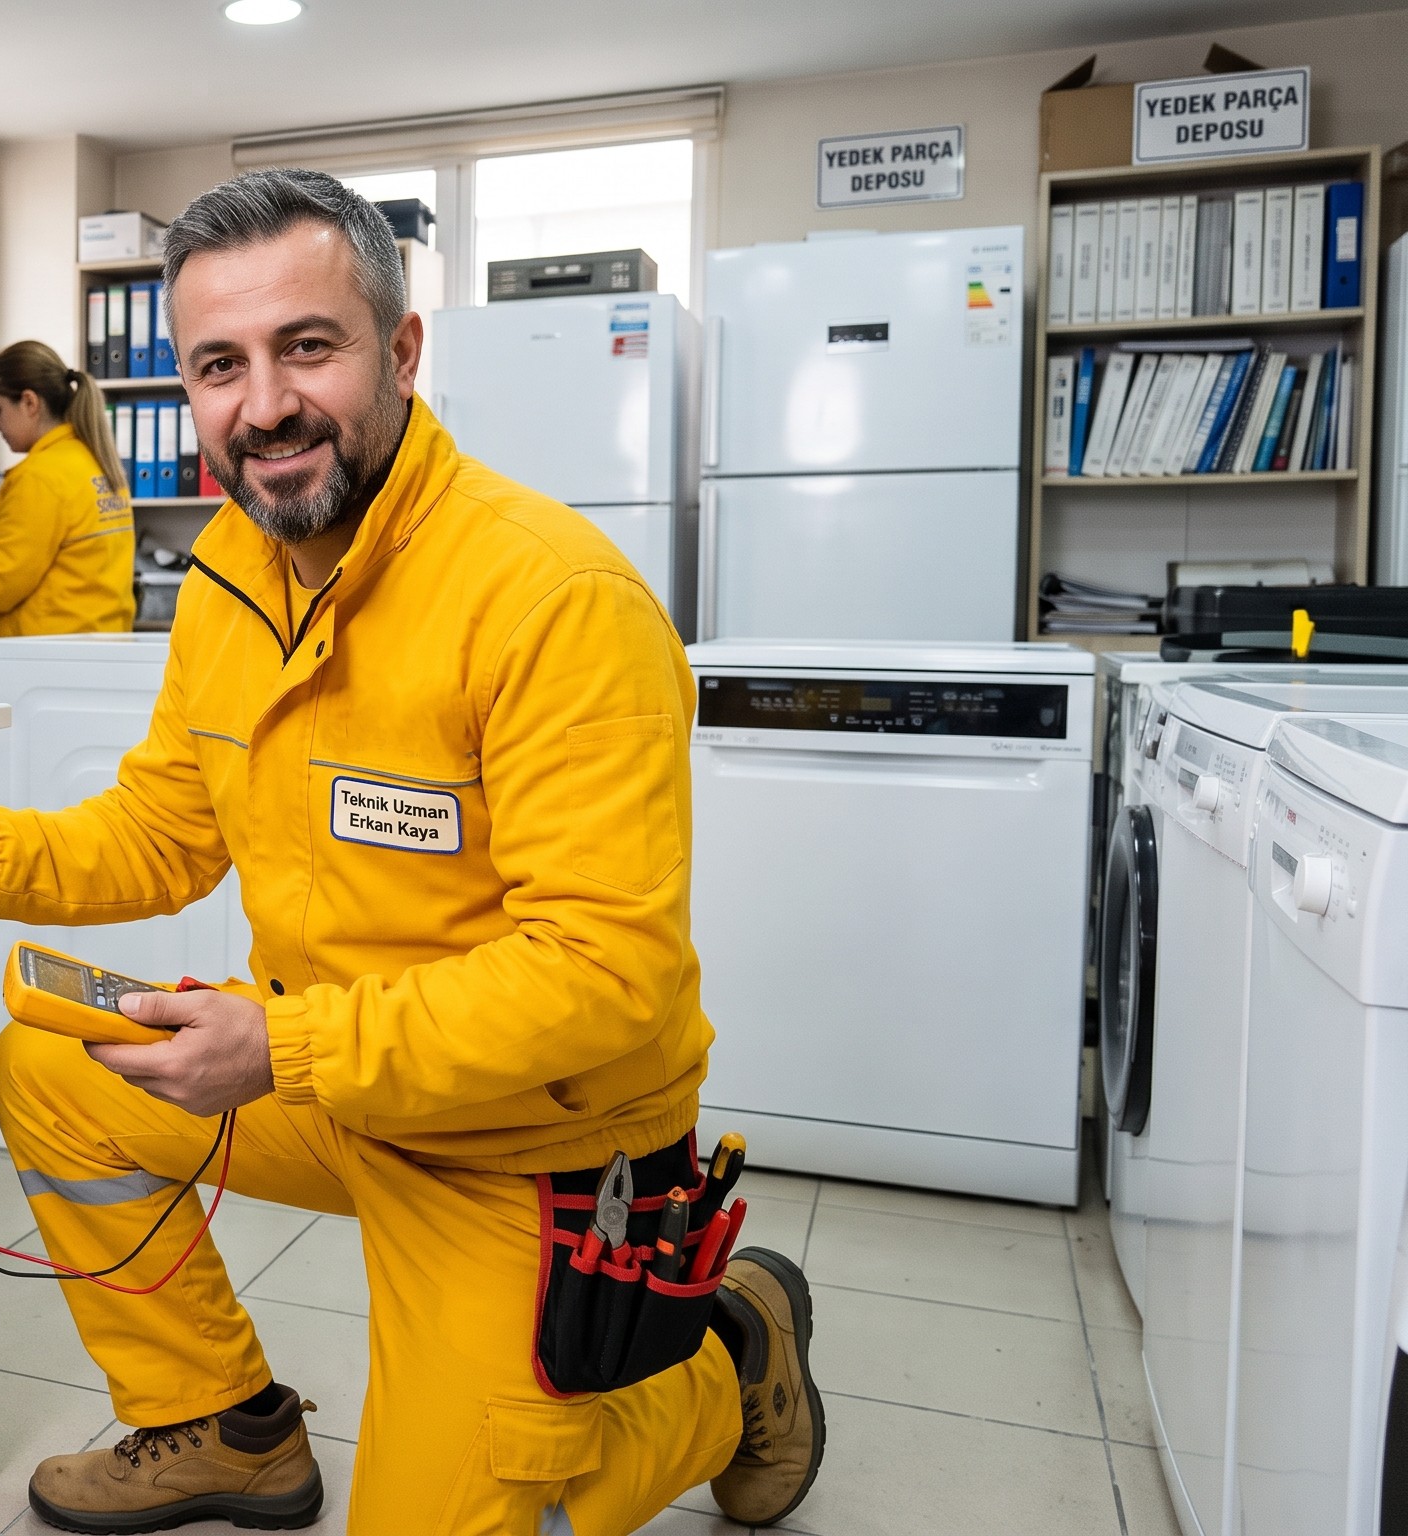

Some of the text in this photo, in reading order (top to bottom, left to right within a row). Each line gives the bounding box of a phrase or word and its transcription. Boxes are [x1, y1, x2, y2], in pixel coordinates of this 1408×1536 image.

[1146, 86, 1299, 118] YEDEK PARÇA
[1176, 119, 1264, 144] DEPOSU
[825, 140, 953, 168] YEDEK PARÇA
[851, 170, 925, 192] DEPOSU
[341, 789, 449, 819] Teknik Uzman
[349, 812, 439, 842] Erkan Kaya
